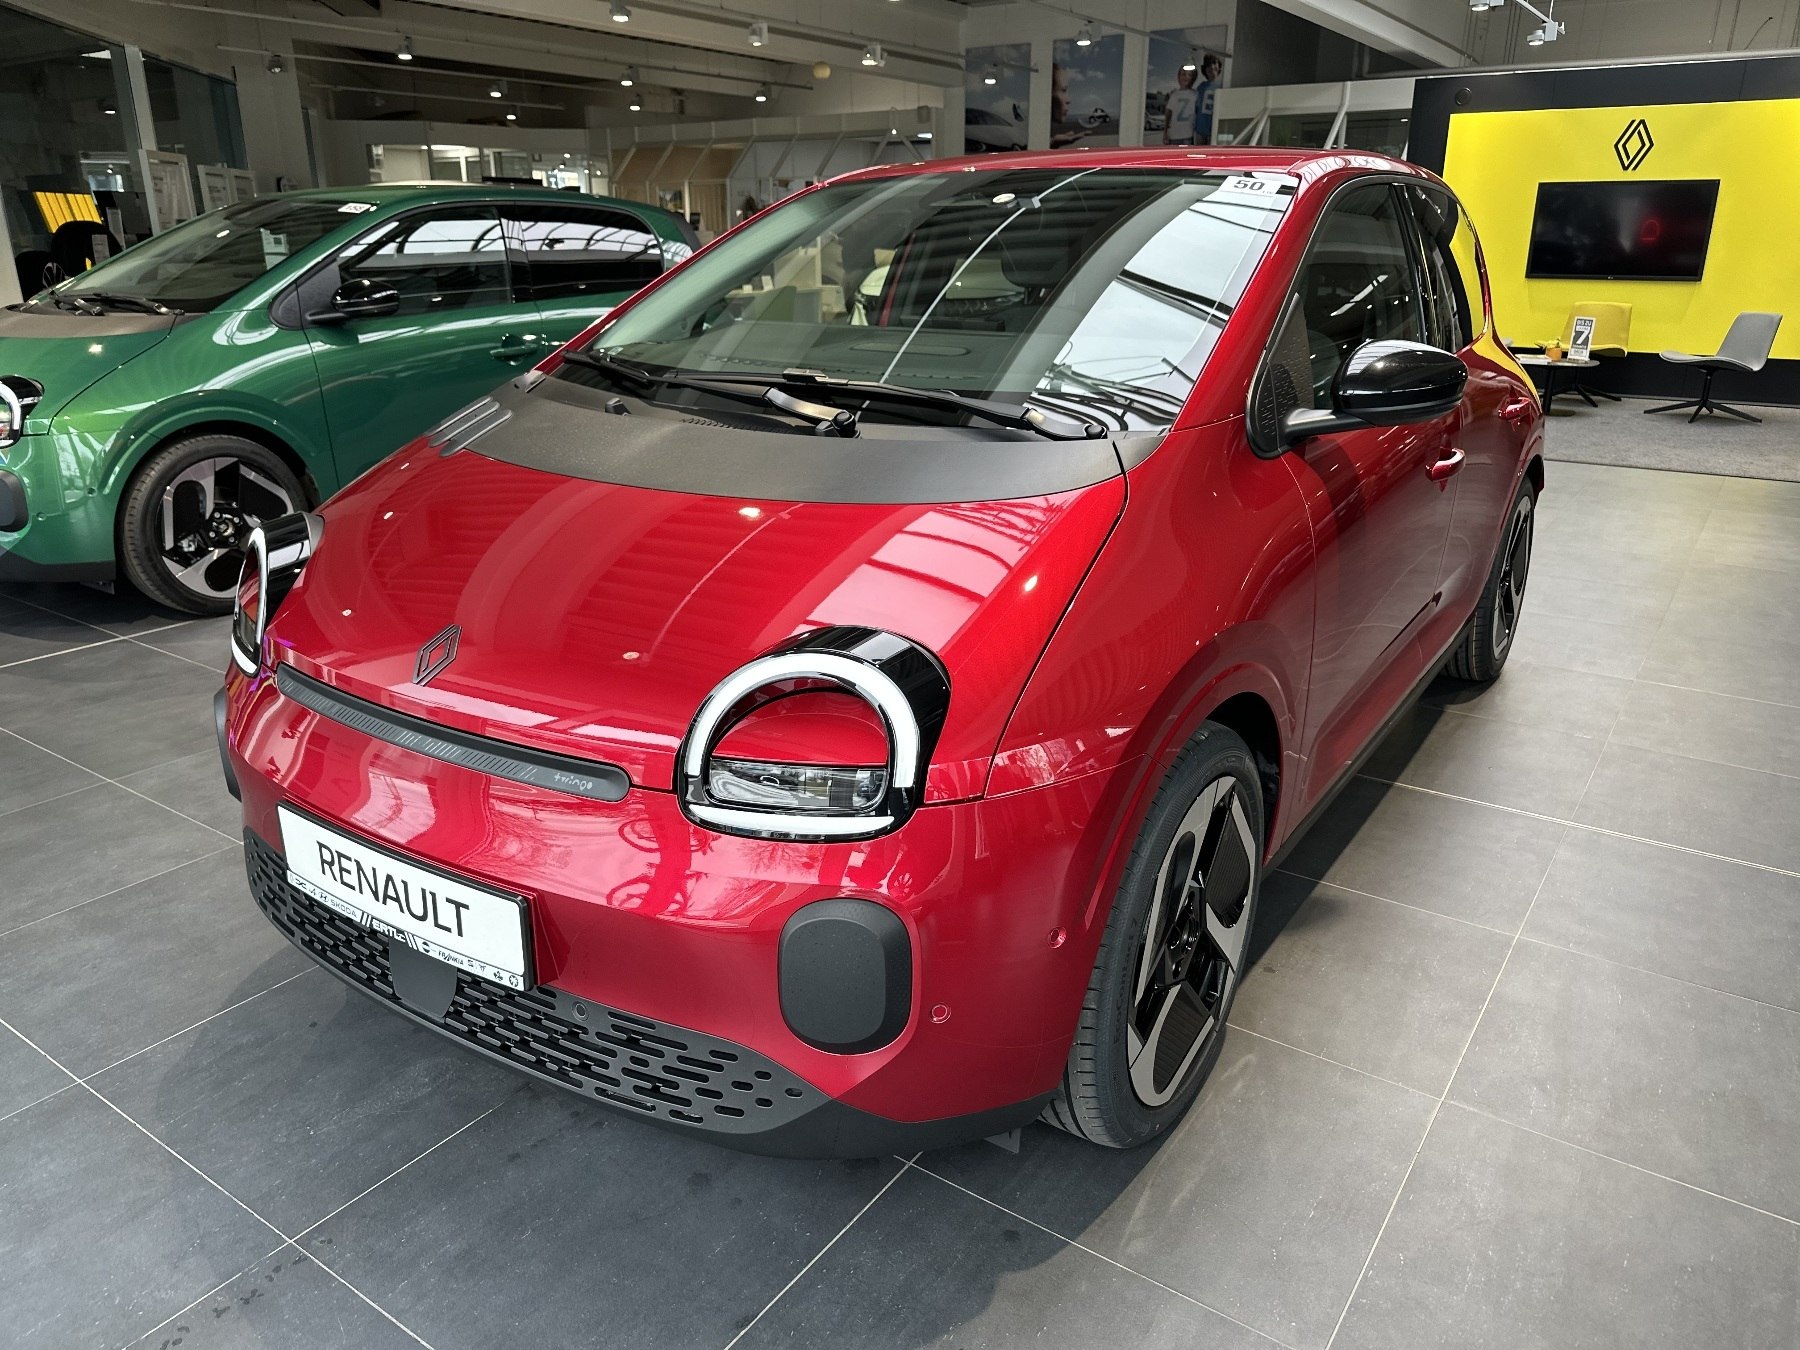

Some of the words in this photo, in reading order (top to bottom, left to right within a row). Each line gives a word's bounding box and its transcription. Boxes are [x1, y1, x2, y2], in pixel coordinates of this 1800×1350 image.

[1233, 179, 1265, 191] 50
[1575, 326, 1590, 344] 7
[554, 772, 593, 791] twingo
[316, 840, 470, 938] RENAULT
